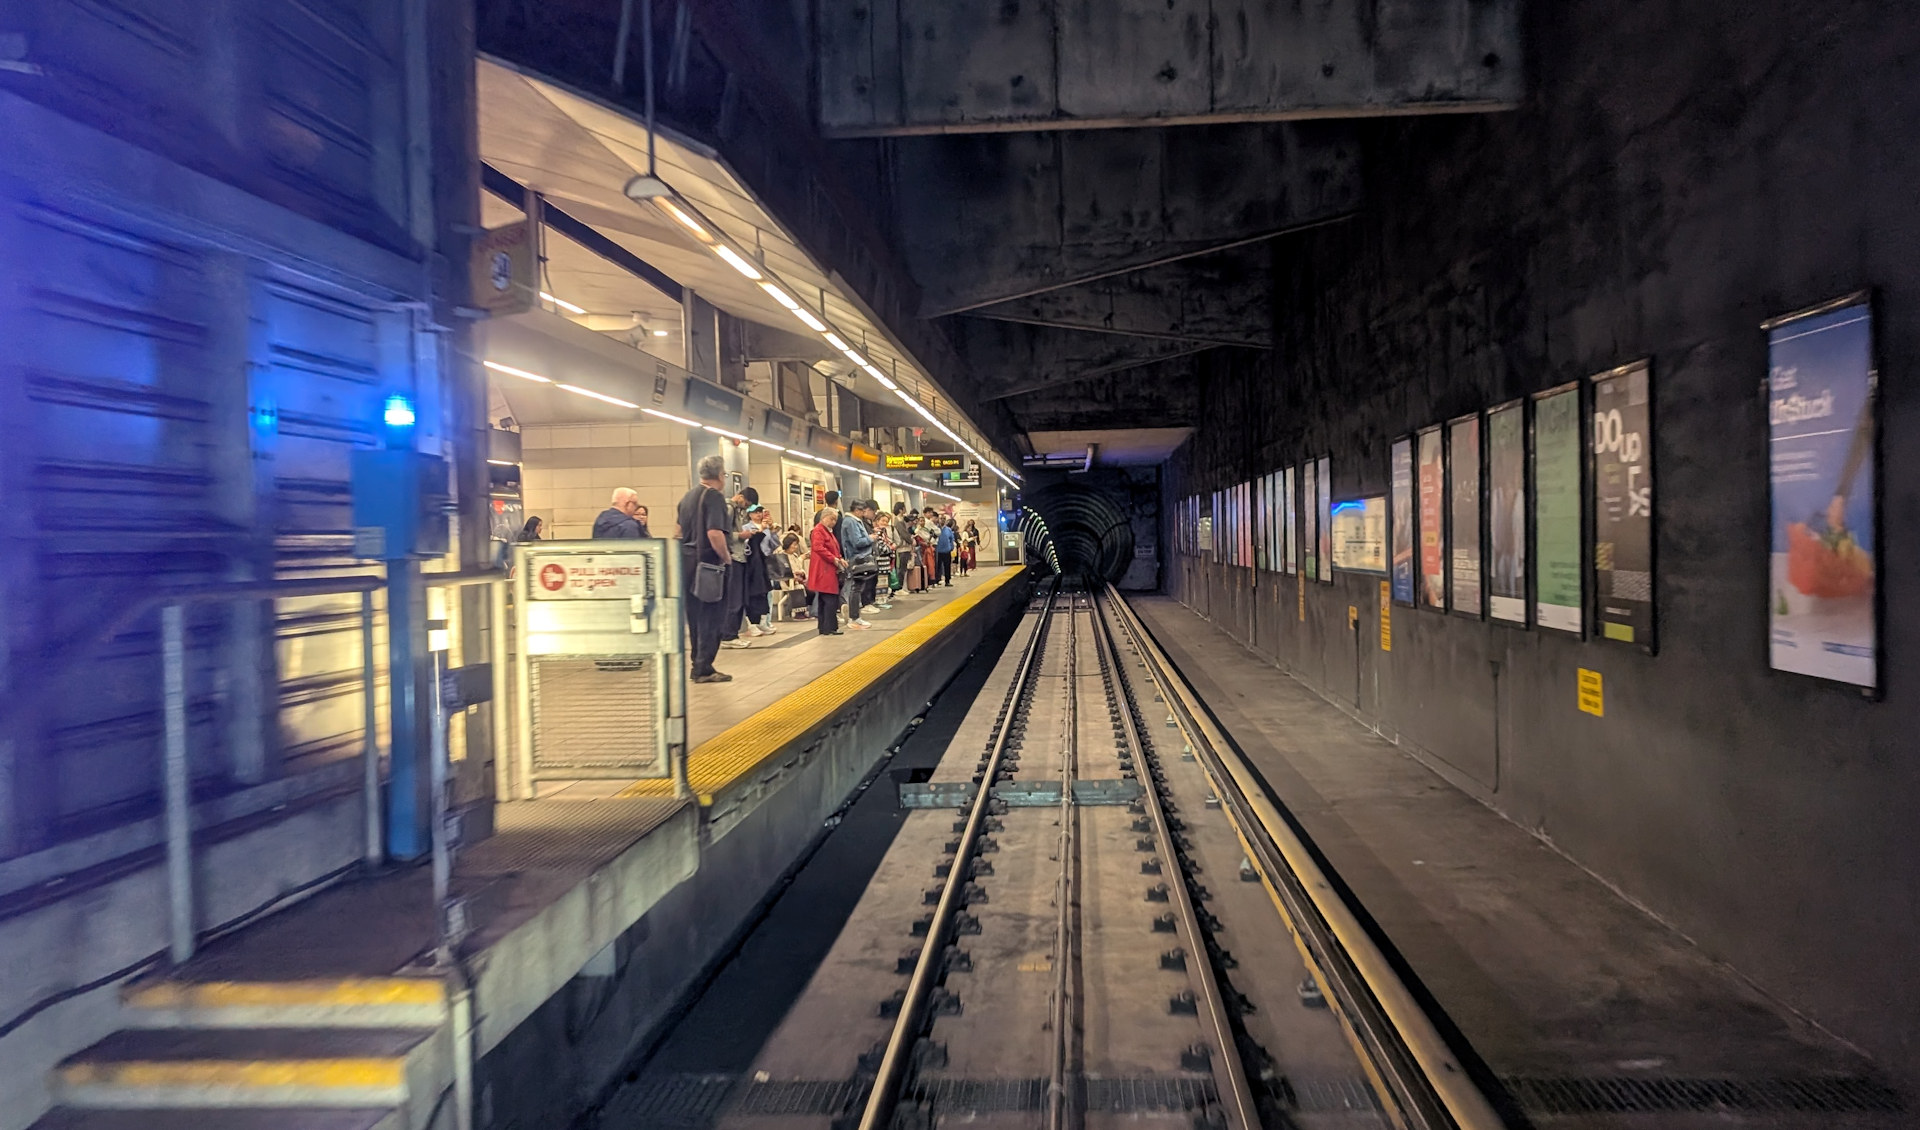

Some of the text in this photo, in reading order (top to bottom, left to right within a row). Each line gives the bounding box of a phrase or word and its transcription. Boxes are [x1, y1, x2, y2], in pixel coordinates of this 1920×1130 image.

[569, 567, 641, 576] PULL HANDLE
[570, 579, 617, 588] TO OPEN
